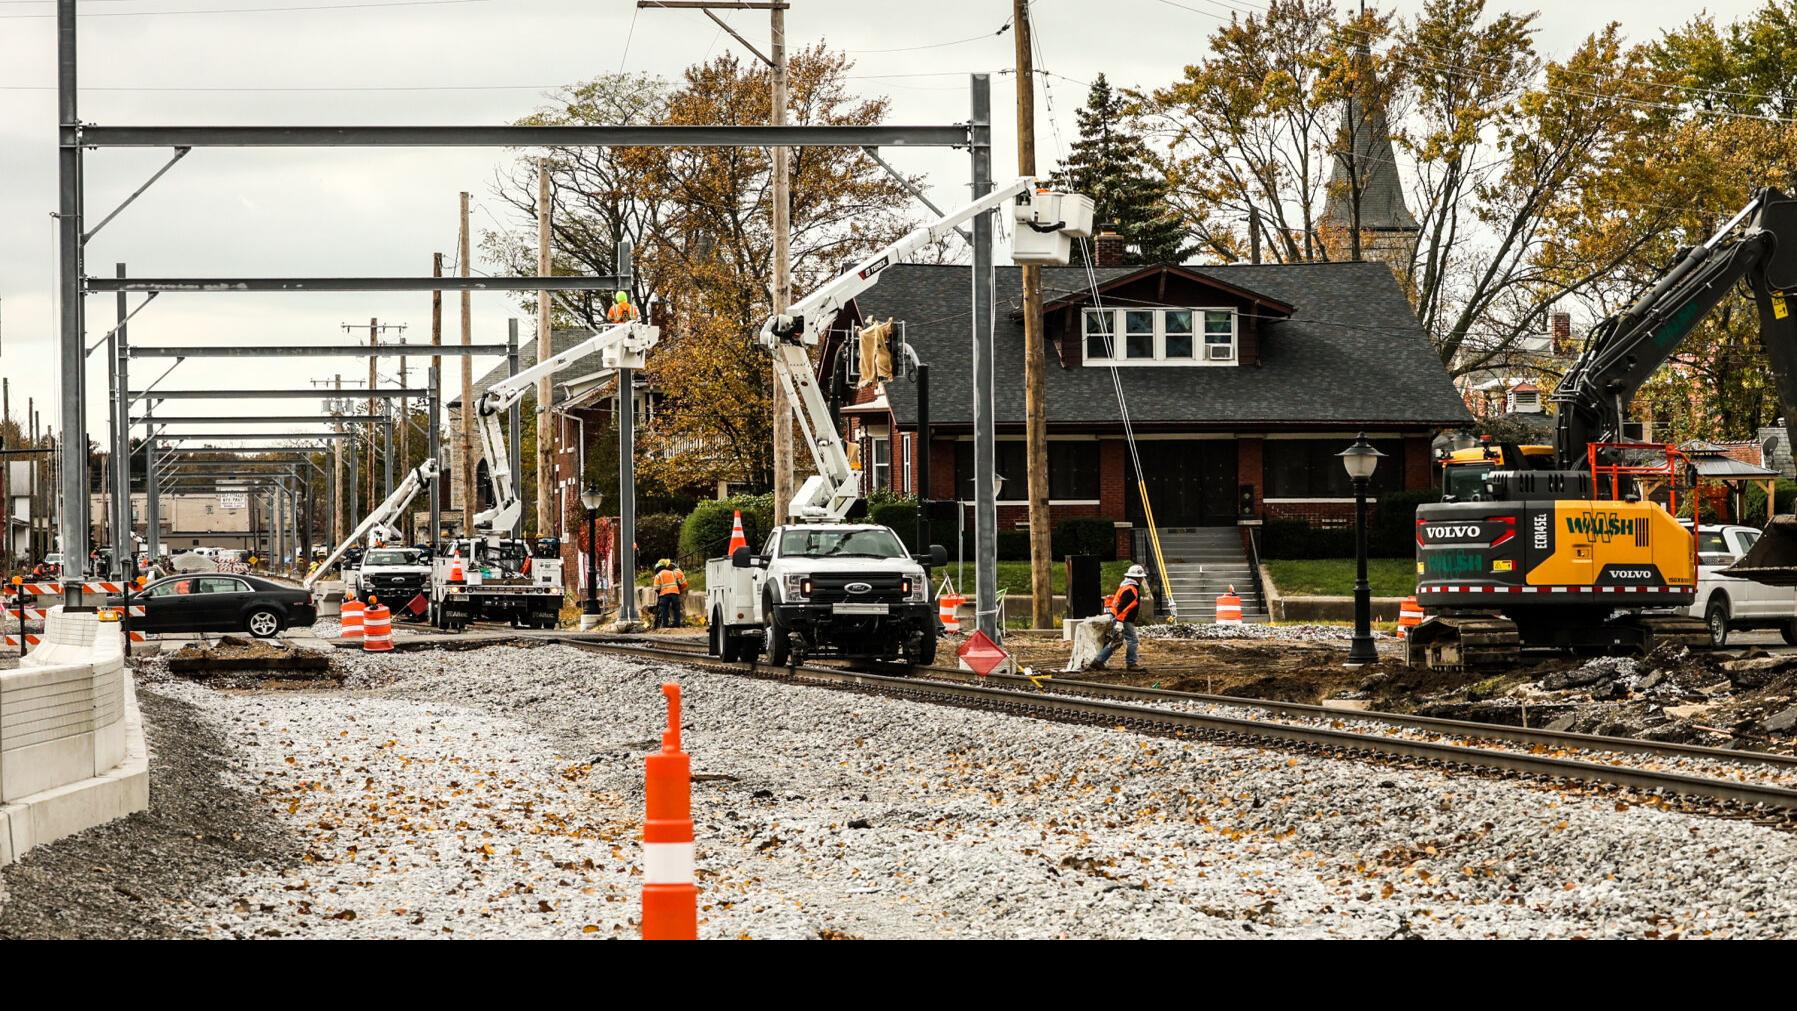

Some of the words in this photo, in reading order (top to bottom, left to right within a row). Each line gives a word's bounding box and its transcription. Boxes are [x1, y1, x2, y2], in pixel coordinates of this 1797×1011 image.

[1566, 516, 1634, 535] WALSH
[1426, 526, 1481, 539] VOLVO
[1609, 570, 1652, 579] VOLVO
